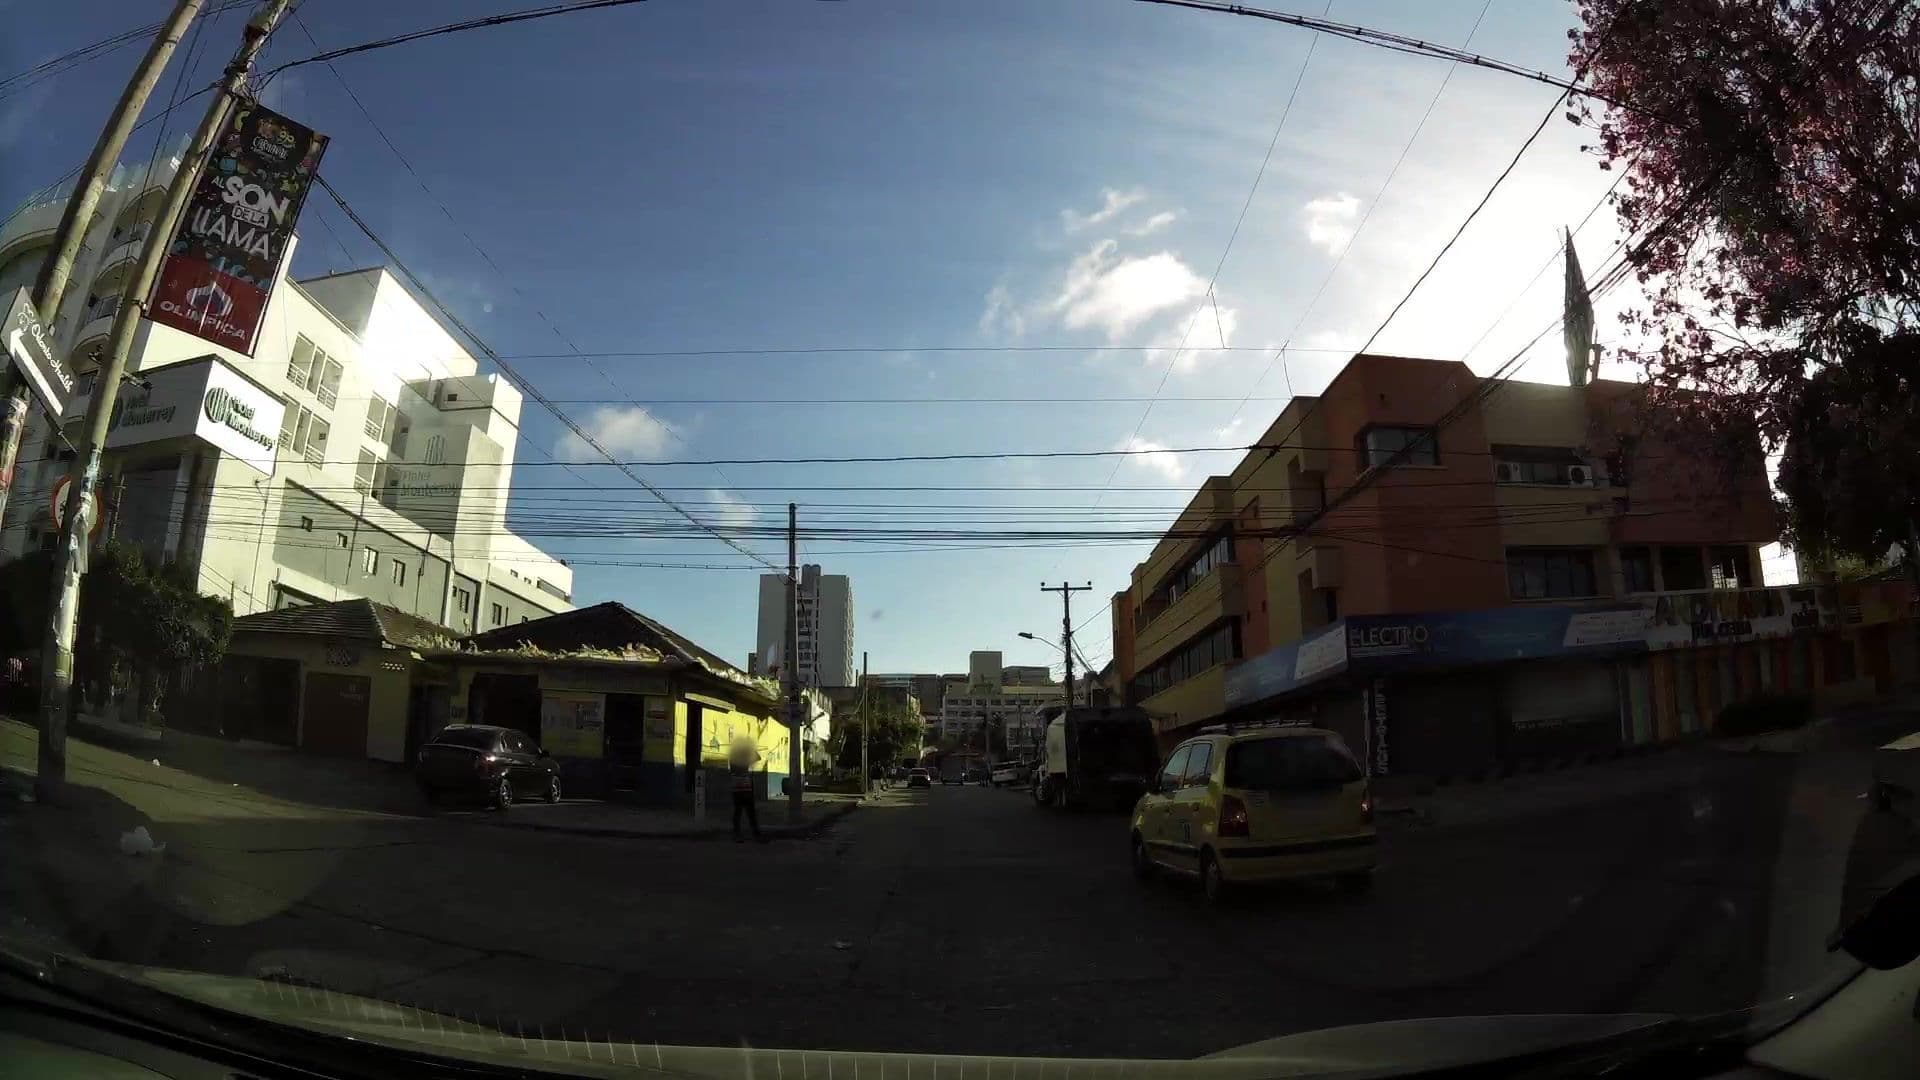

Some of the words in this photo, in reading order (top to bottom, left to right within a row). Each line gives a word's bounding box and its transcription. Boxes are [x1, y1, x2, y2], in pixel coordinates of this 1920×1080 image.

[210, 175, 225, 189] AL
[221, 175, 291, 225] SON
[234, 207, 249, 219] DE
[250, 211, 266, 225] LA
[229, 396, 256, 420] Hotel
[225, 412, 274, 452] Monterrey
